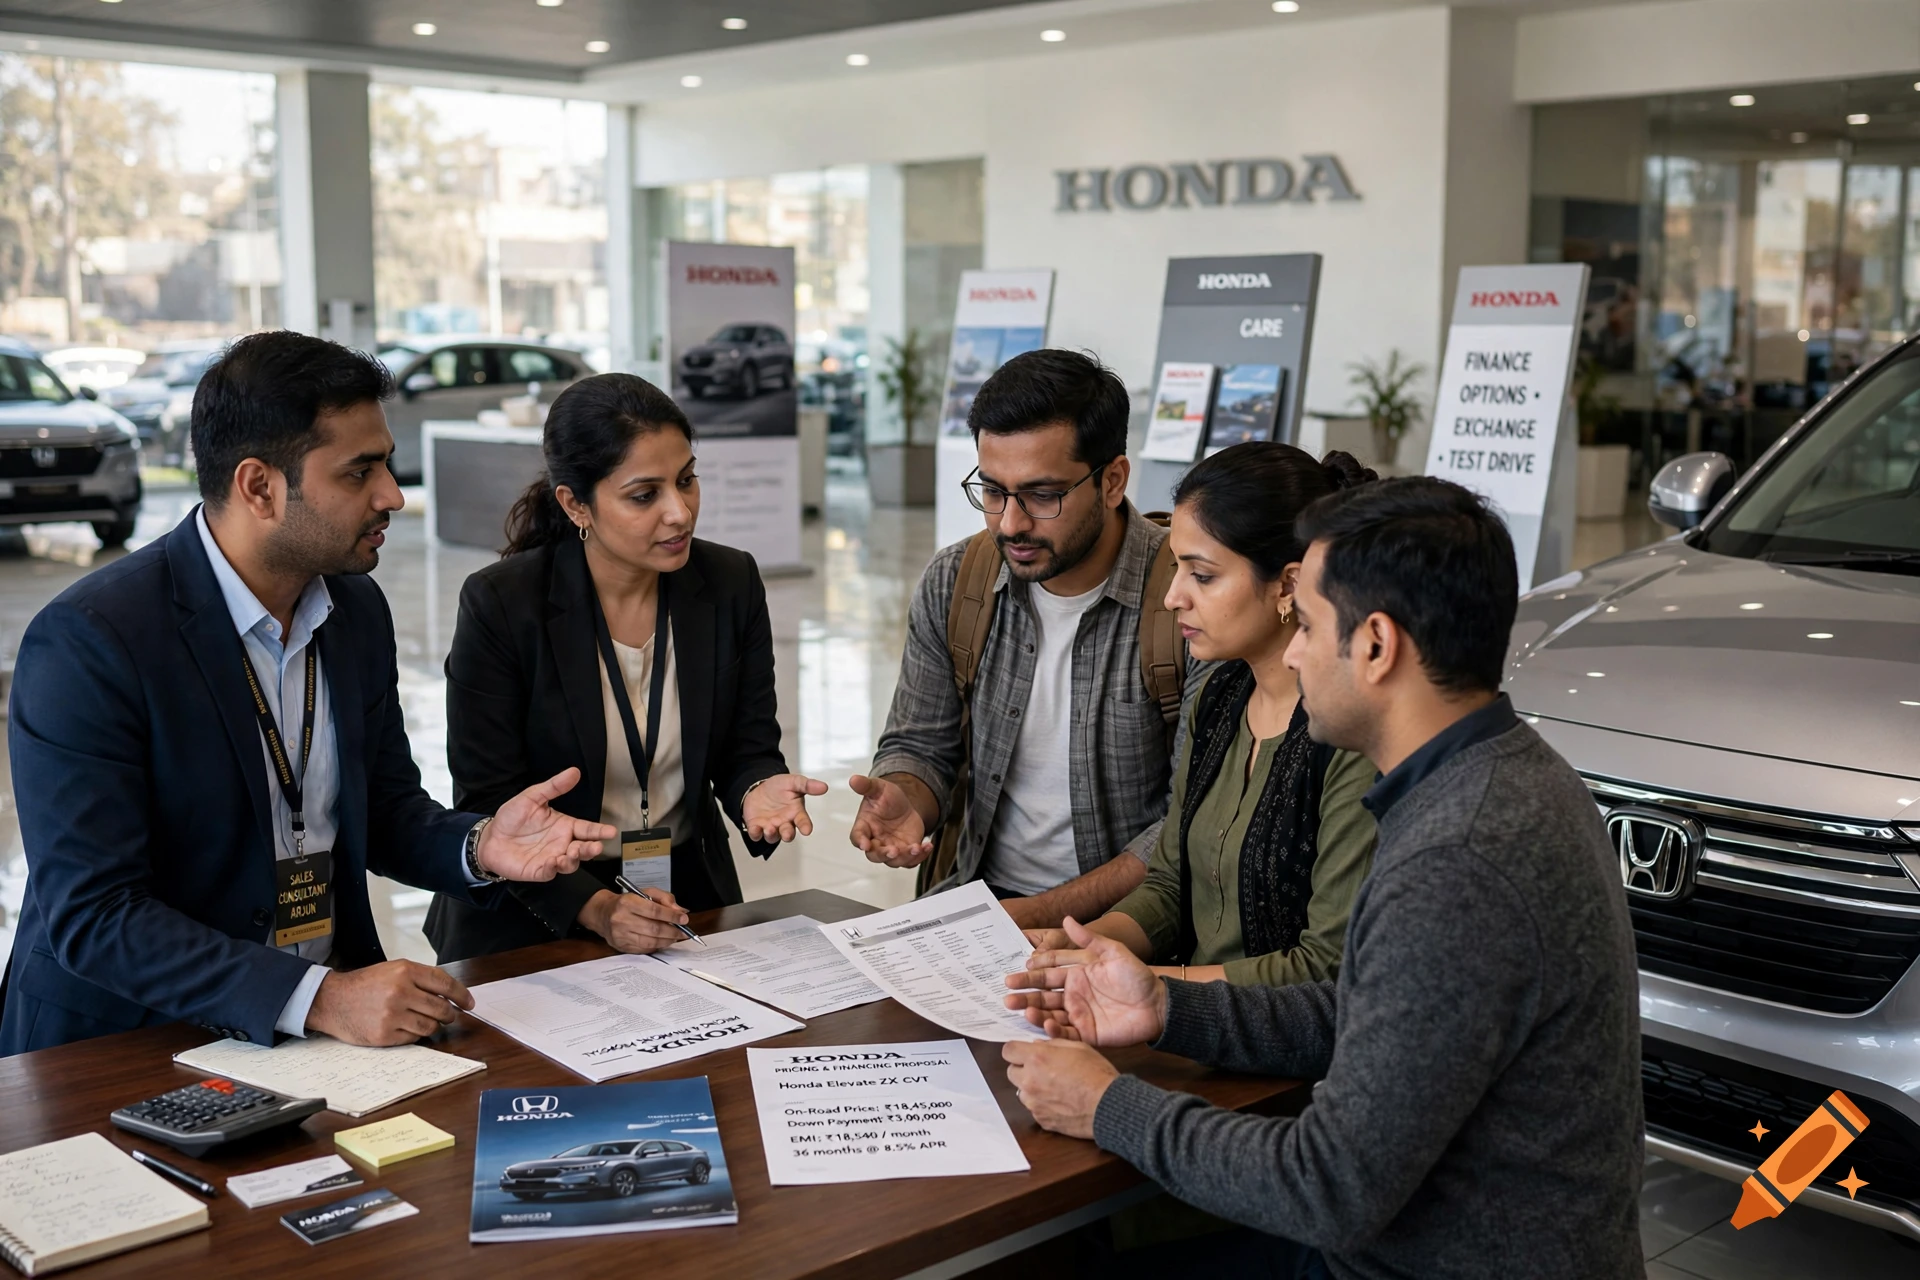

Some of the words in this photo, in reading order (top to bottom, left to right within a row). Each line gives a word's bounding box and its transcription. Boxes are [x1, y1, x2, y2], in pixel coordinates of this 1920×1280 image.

[1055, 154, 1362, 212] HONDA
[686, 265, 779, 286] HONDA
[1197, 273, 1272, 289] HONDA
[969, 287, 1037, 302] HONDA
[1470, 291, 1559, 307] HONDA
[1240, 318, 1283, 338] CARE
[1464, 352, 1532, 372] FINANCE
[1460, 384, 1527, 405] OPTIONS
[1453, 417, 1537, 439] EXCHANGE
[1449, 450, 1484, 470] TEST
[1488, 453, 1535, 474] DRIVE
[290, 870, 314, 886] SALES
[637, 1023, 753, 1054] HONDA
[790, 1052, 905, 1063] HONDA
[833, 1062, 892, 1071] FINANCING
[894, 1060, 951, 1068] PROPOSAL
[779, 1081, 823, 1089] Honda
[826, 1078, 877, 1088] Elevate
[879, 1077, 898, 1085] ZX
[902, 1076, 929, 1084] CVT
[497, 1112, 575, 1122] HONDA
[784, 1106, 841, 1116] On-Road
[844, 1105, 880, 1113] Price:
[787, 1120, 825, 1128] Down
[790, 1135, 822, 1144] EMI:
[890, 1129, 932, 1138] month
[793, 1148, 809, 1157] 36
[813, 1145, 863, 1156] months
[884, 1143, 916, 1152] 8.5%
[919, 1140, 948, 1150] APR
